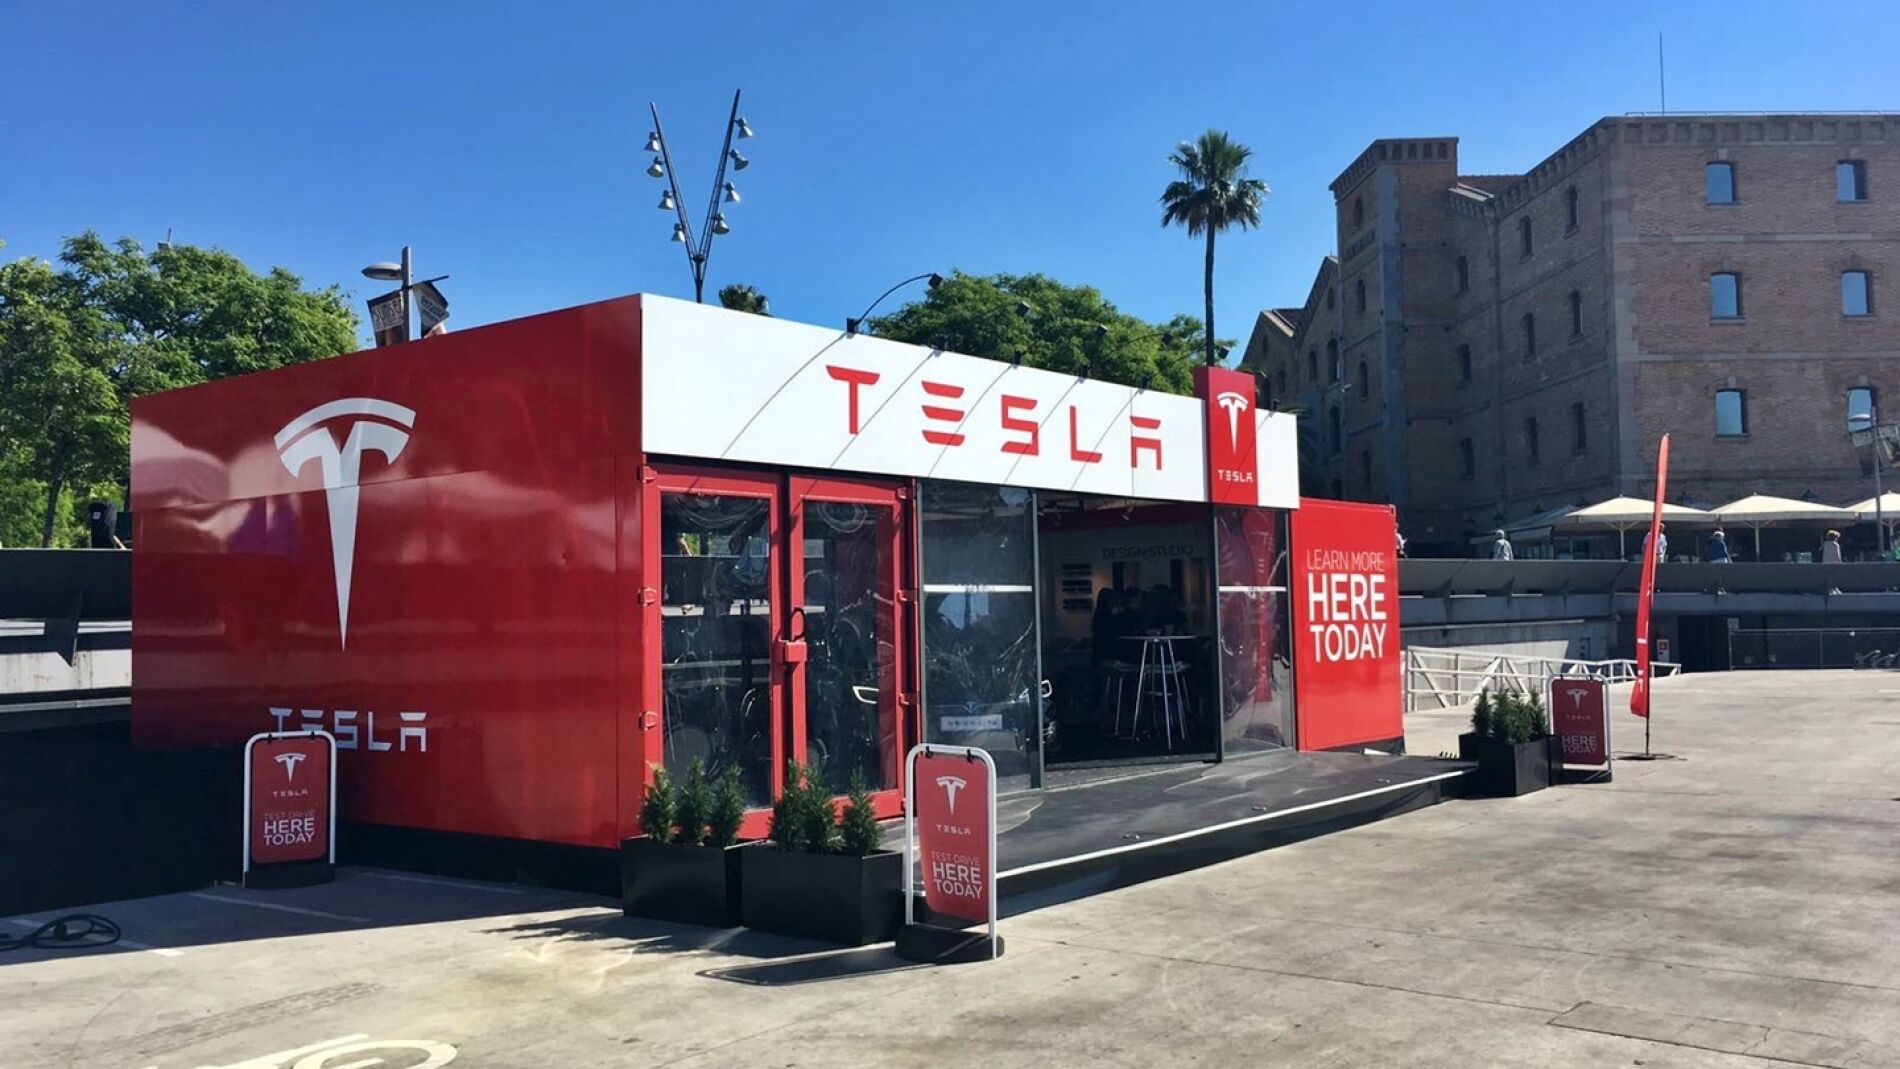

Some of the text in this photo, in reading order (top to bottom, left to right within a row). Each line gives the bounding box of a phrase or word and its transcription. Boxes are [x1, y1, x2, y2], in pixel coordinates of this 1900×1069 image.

[826, 364, 1162, 470] TESLA
[1217, 469, 1253, 483] TESLA
[1306, 549, 1385, 572] LEARN MORE
[1307, 573, 1387, 621] HERE
[1309, 623, 1388, 663] TODAY
[1561, 735, 1597, 745] HERE
[1561, 744, 1597, 753] TODAY
[272, 789, 309, 798] TESLA
[264, 817, 315, 835] HERE
[936, 823, 972, 835] TESLA
[263, 831, 315, 846] TODAY
[931, 851, 981, 867] TEST DRIVE
[932, 861, 982, 884] HERE
[934, 879, 983, 899] TODAY
